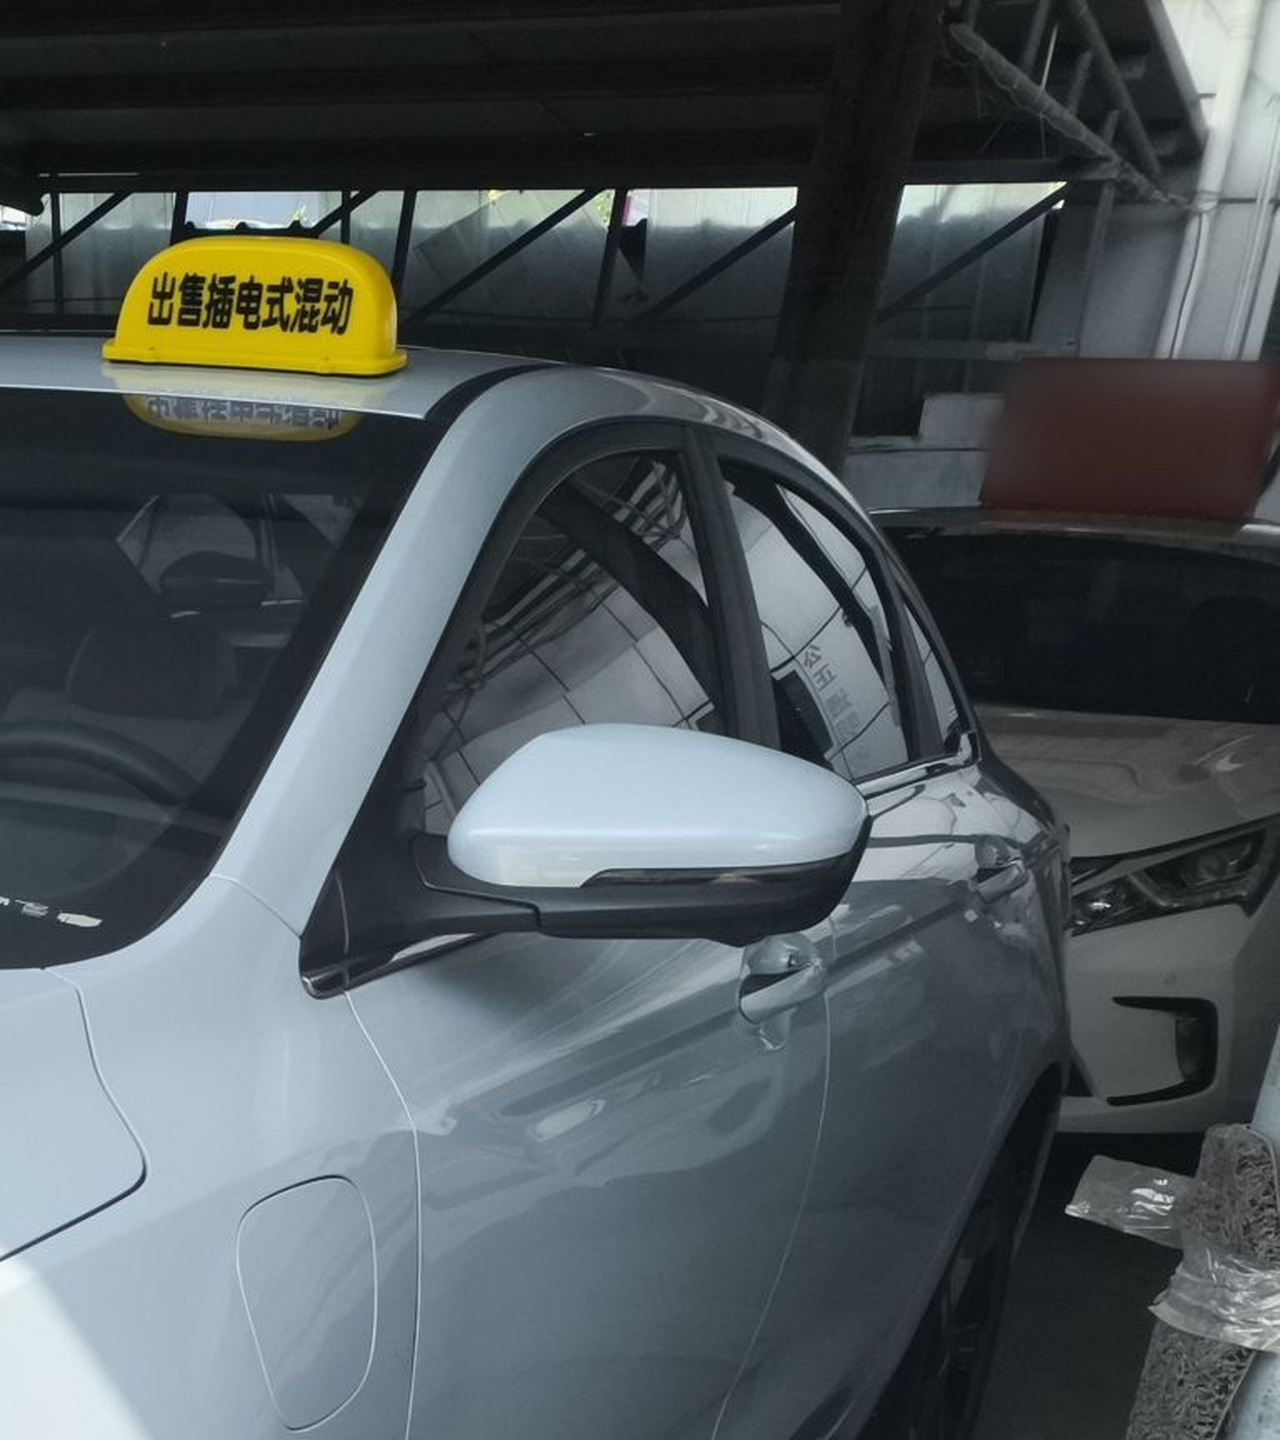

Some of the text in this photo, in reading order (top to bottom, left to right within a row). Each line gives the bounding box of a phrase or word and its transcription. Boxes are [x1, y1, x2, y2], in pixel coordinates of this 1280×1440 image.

[146, 271, 354, 336] 出售插电式混动
